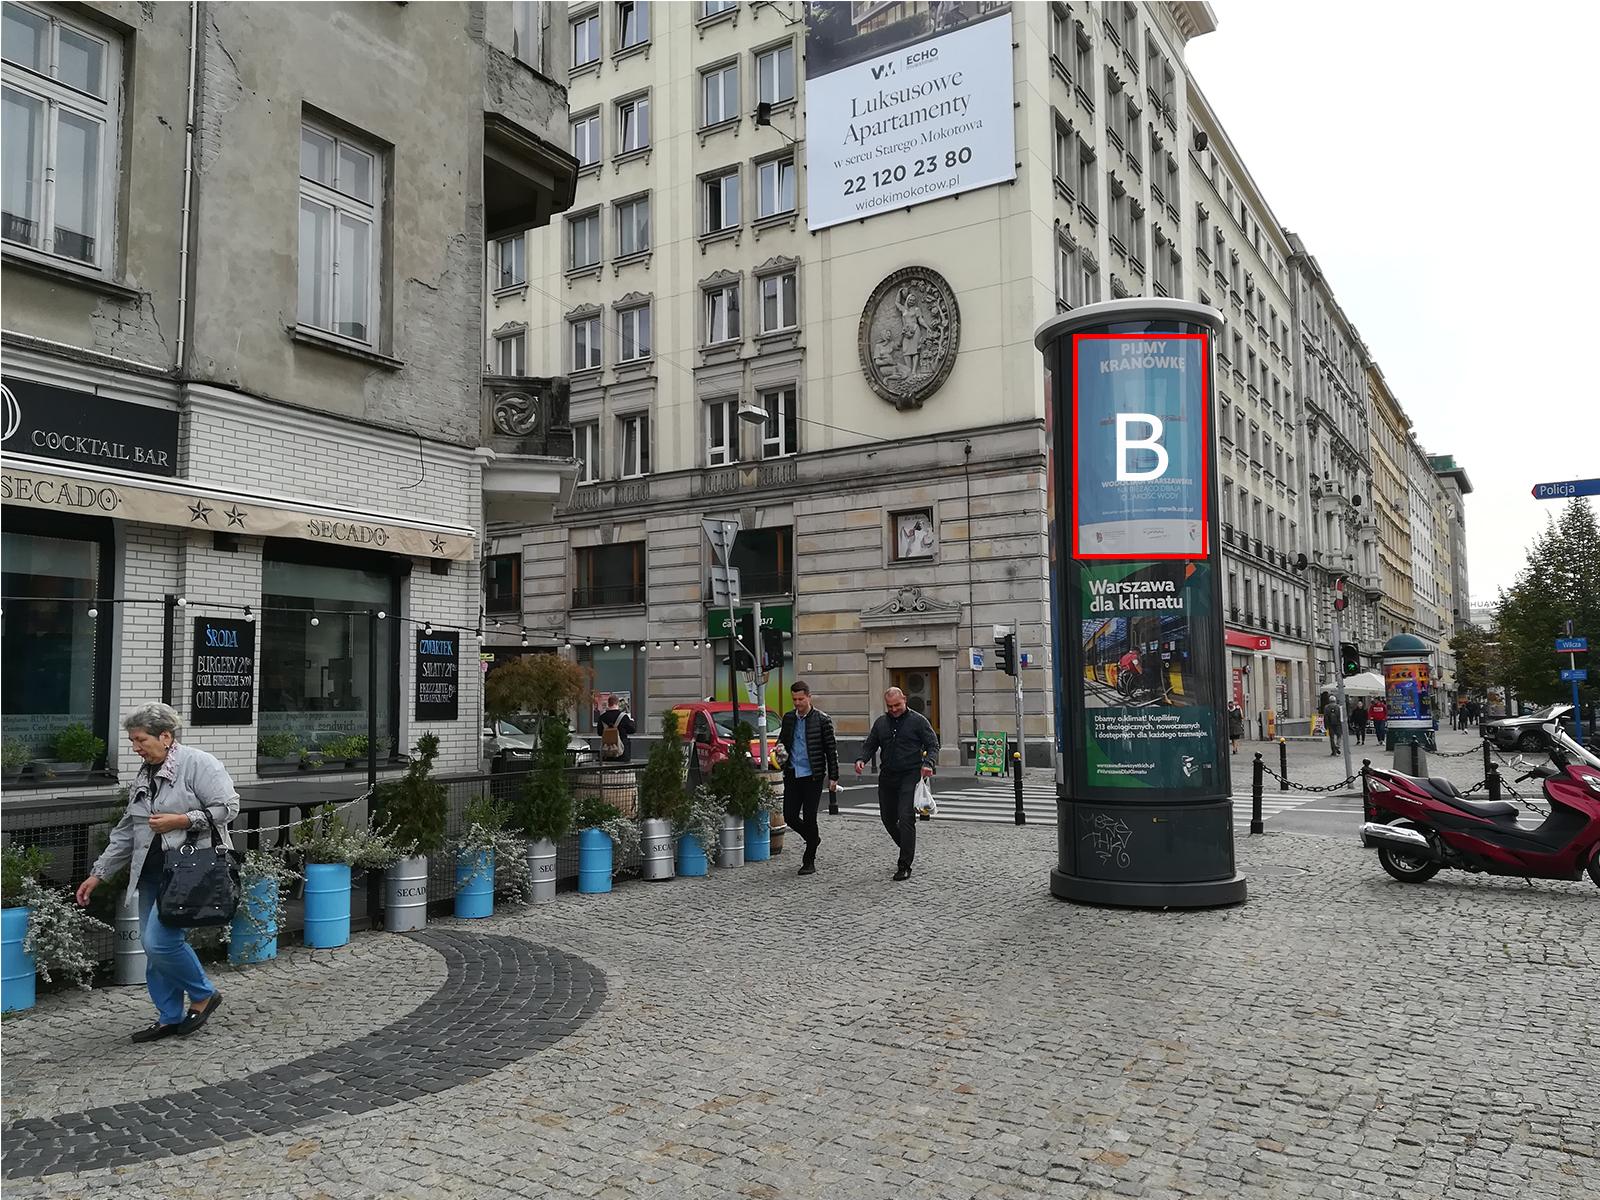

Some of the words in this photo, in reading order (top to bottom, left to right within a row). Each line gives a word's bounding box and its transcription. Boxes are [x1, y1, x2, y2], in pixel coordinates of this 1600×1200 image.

[906, 47, 939, 65] ECHO
[850, 71, 963, 118] Luksusowe
[843, 94, 972, 146] Apartamenty
[834, 160, 843, 169] w
[845, 152, 873, 166] sercu
[875, 137, 918, 156] Starego
[920, 119, 983, 144] Mokotowa
[843, 175, 866, 196] 22
[872, 165, 906, 188] 120
[913, 155, 938, 177] 23
[944, 146, 972, 169] 80
[855, 174, 960, 211] widokimokotow.pl
[1121, 341, 1167, 356] PIJMY
[1100, 353, 1185, 373] KRANÓWKĘ
[31, 429, 130, 460] COCKTAIL
[133, 446, 169, 467] BAR
[0, 475, 118, 511] SECADO
[1540, 483, 1576, 496] Policja
[308, 519, 387, 546] SECADO
[1088, 579, 1175, 595] Warszawa
[1089, 596, 1115, 612] dla
[1119, 594, 1184, 610] klimatu
[205, 624, 239, 648] ŚRODA
[420, 640, 453, 655] CZWARTEK
[197, 656, 237, 673] BURGERY
[1094, 715, 1117, 723] Dbamy
[1148, 714, 1181, 723] Kupiliśmy
[1106, 723, 1155, 731] ekologicznych,
[1156, 722, 1200, 730] nowoczesnych
[1098, 731, 1136, 740] dostępnych
[1148, 731, 1177, 739] każdego
